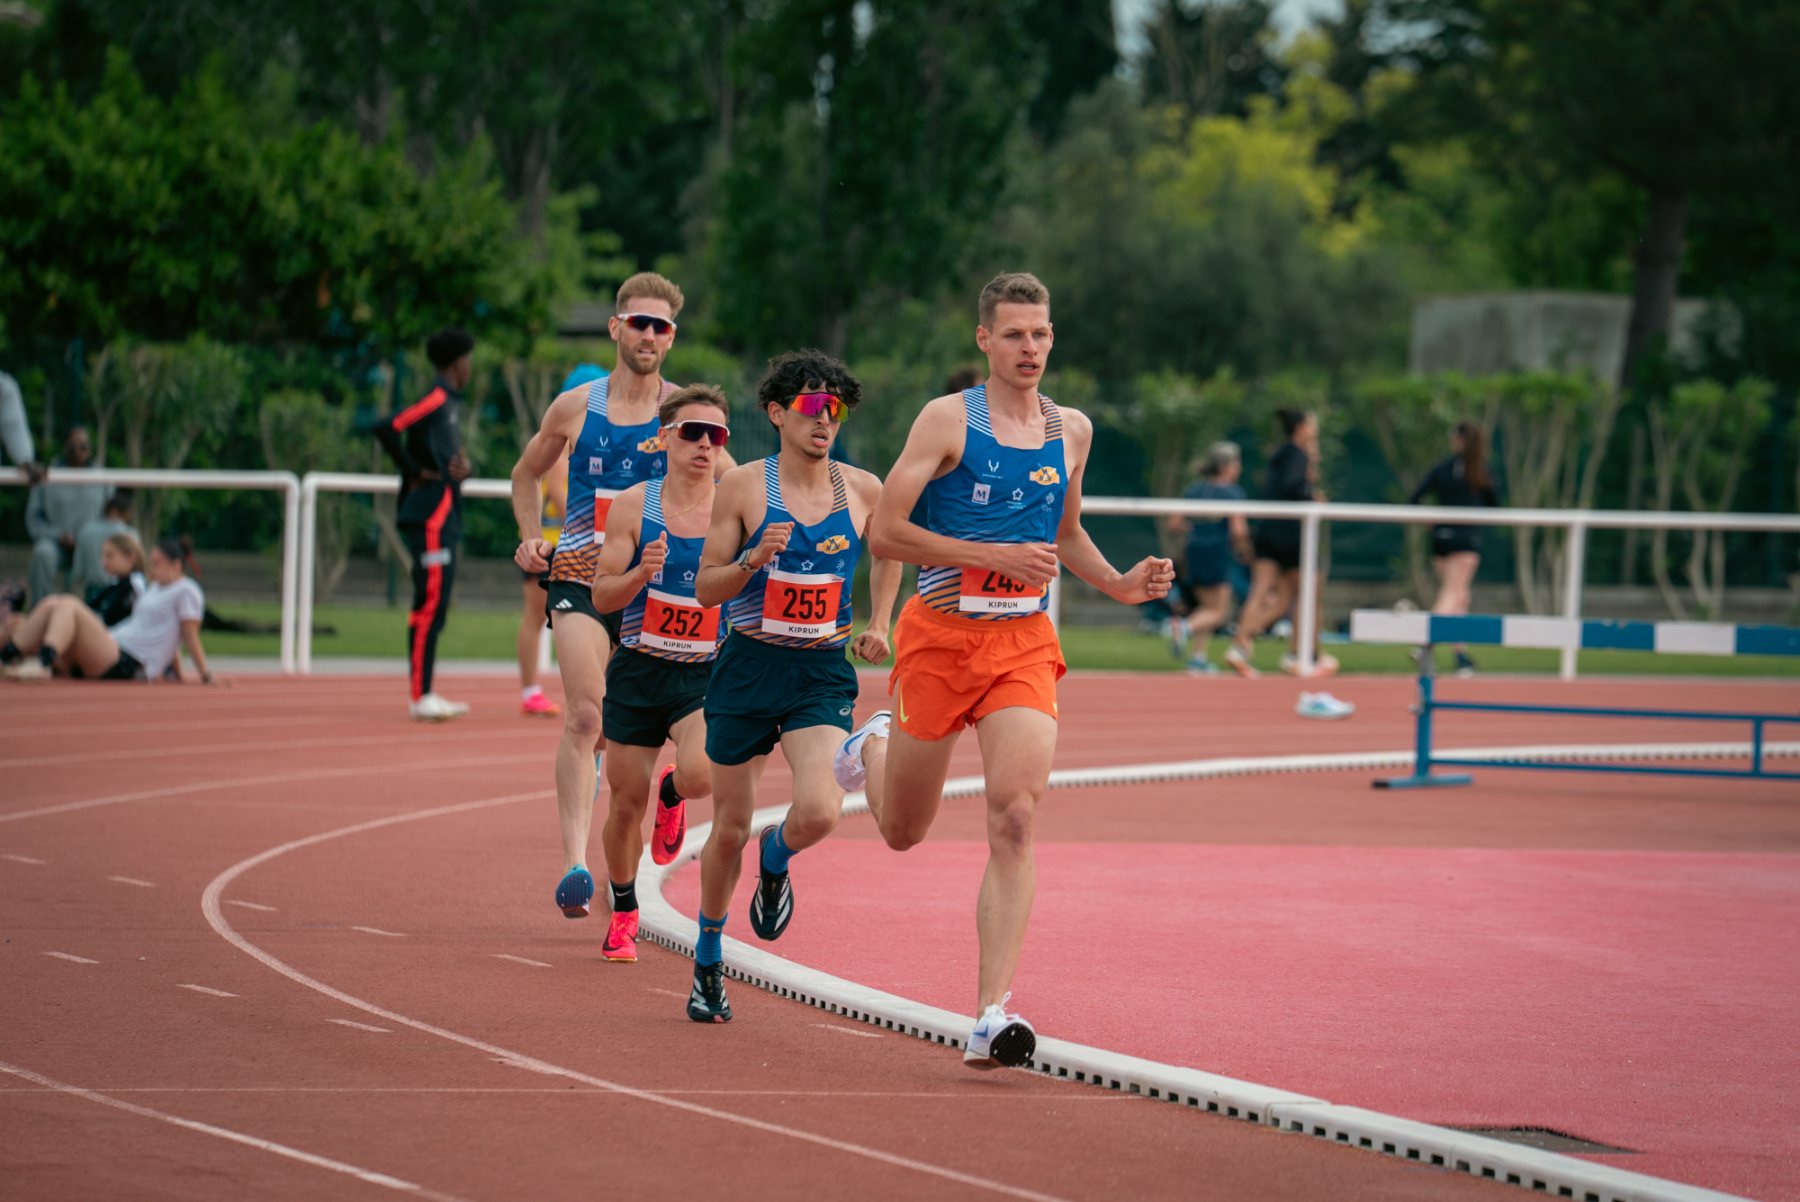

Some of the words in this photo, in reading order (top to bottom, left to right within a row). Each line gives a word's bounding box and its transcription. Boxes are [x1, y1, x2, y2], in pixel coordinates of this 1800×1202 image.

[976, 489, 987, 499] M
[782, 587, 828, 620] 255
[988, 601, 1019, 609] KIPRUN
[659, 606, 704, 638] 252
[788, 625, 820, 635] KIPRUN
[663, 640, 692, 650] KIPRUN
